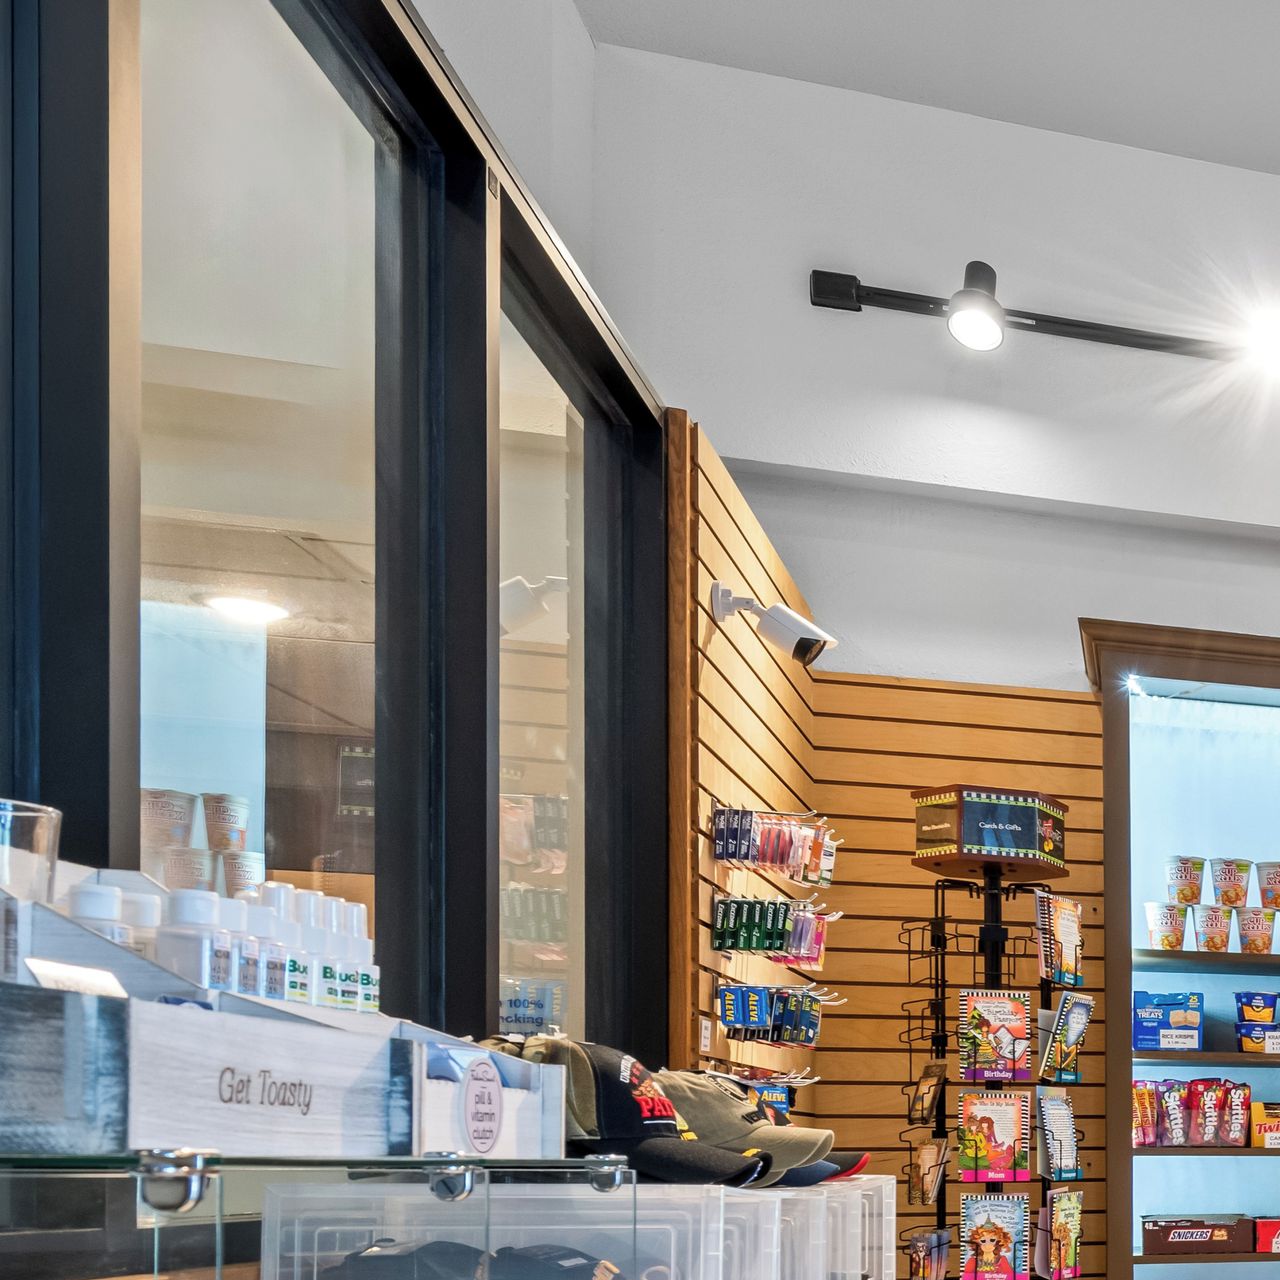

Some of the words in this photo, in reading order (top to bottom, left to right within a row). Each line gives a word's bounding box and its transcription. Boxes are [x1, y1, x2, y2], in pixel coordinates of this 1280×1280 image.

[979, 821, 998, 830] Cards
[1005, 823, 1022, 831] Gifts
[509, 998, 544, 1009] 100%
[725, 992, 735, 1021] ALEVE
[749, 992, 759, 1022] ALEVE
[1137, 1012, 1163, 1020] TREATS
[984, 1070, 1013, 1079] Birthday
[218, 1067, 251, 1105] Get
[258, 1069, 313, 1116] Toasty
[761, 1090, 786, 1102] ALEVE
[471, 1110, 495, 1123] vitamin
[1203, 1090, 1216, 1142] Skittles
[1230, 1081, 1245, 1140] Skittles
[1163, 1091, 1185, 1146] Skittles
[473, 1127, 494, 1140] clutch
[988, 1171, 1005, 1179] Mom
[1169, 1229, 1211, 1241] SNICKERS
